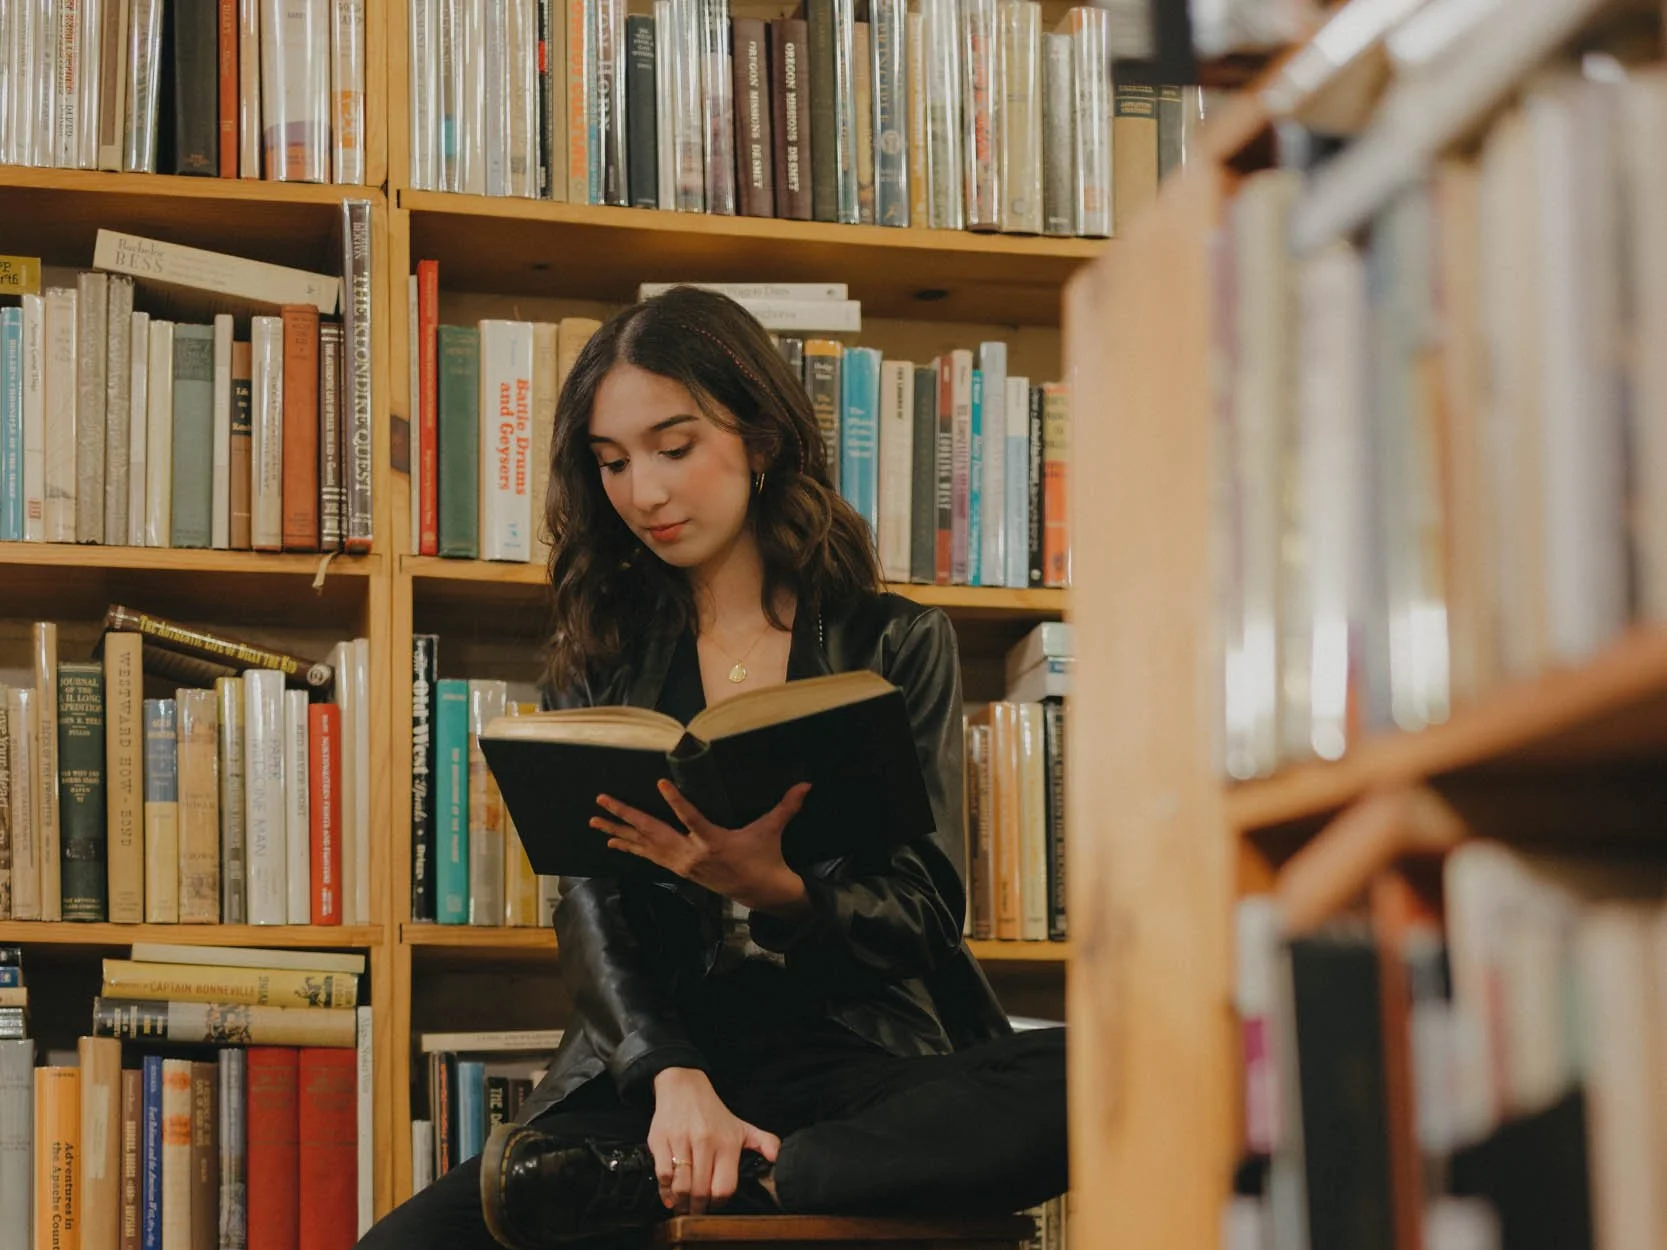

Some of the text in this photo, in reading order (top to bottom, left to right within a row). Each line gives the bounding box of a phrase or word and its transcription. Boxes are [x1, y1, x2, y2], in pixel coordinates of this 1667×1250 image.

[748, 40, 763, 189] OREGON MISSIONS DE SMET
[785, 42, 800, 191] OREGON MISSIONS DE SMET
[115, 251, 163, 273] BESS
[353, 272, 371, 496] THE KLONDIKE QUEST
[496, 383, 514, 491] and Geysers
[516, 378, 529, 495] Battle Drums
[204, 634, 224, 654] LIFE
[263, 653, 280, 670] THE
[282, 655, 298, 674] KID
[60, 678, 99, 687] JOURNAL
[413, 681, 428, 720] Old
[119, 652, 132, 848] WESTWARD HOW BOND
[413, 723, 428, 774] West
[253, 820, 266, 857] MAN
[150, 981, 191, 994] CAPTAIN
[196, 983, 255, 996] BONNEVILLE
[489, 1087, 503, 1109] THE
[51, 1141, 62, 1160] the
[51, 1166, 62, 1211] Apache
[64, 1141, 74, 1230] Adventures in
